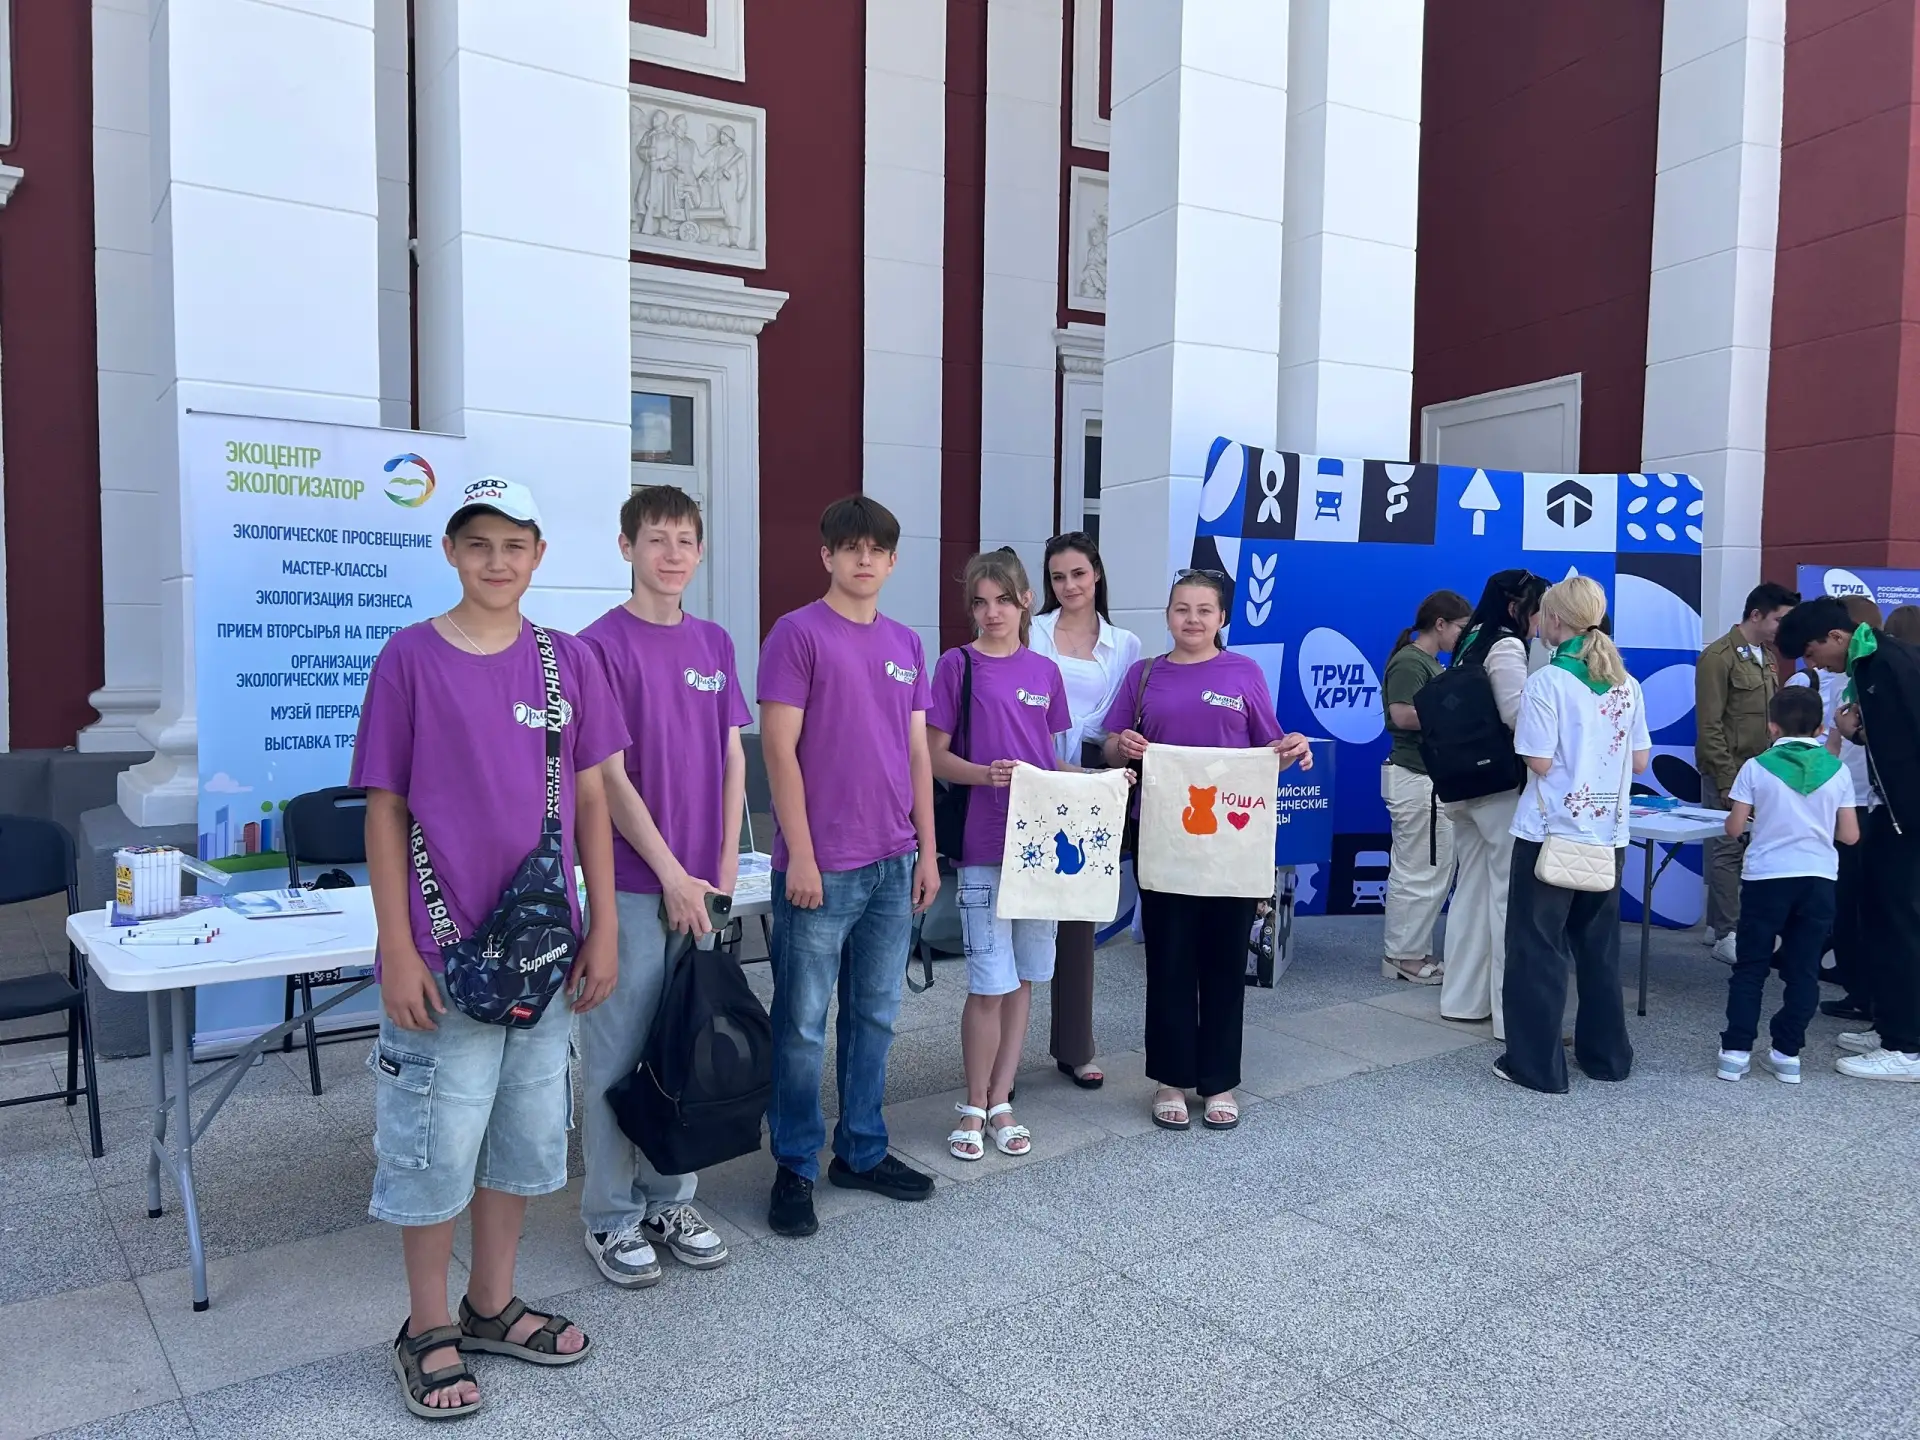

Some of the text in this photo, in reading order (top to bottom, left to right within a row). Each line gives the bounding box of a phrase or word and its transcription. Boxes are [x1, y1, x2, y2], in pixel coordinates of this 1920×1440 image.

[225, 441, 321, 469] ЭКОЦЕНТР
[226, 471, 364, 500] ЭКОЛОГИЗАТОР
[233, 523, 433, 549] ЭКОЛОГИЧЕСКОЕ ПРОСВЕЩЕНИЕ
[282, 560, 387, 578] МАСТЕР-КЛАССЫ
[1832, 584, 1864, 594] ТРУД
[256, 590, 413, 609] ЭКОЛОГИЗАЦИЯ БИЗНЕСА
[217, 623, 402, 640] ПРИЕМ ВТОРСЫРЬЯ НА ПЕРЕ
[236, 673, 369, 688] ЭКОЛОГИЧЕСКИХ МЕР
[533, 626, 562, 733] KUCHEN&BA
[1310, 664, 1365, 686] ТРУД
[1314, 687, 1378, 709] КРУТ
[271, 702, 363, 720] МУЗЕЙ ПЕРЕРА
[264, 734, 357, 751] ВЫСТАВКА ТРЭ
[1277, 784, 1321, 797] ИЙСКИЕ
[1221, 792, 1266, 810] ЮША
[1276, 799, 1328, 811] ЕНЧЕСКИЕ
[1276, 814, 1291, 825] ДЫ
[519, 942, 568, 973] Supreme
